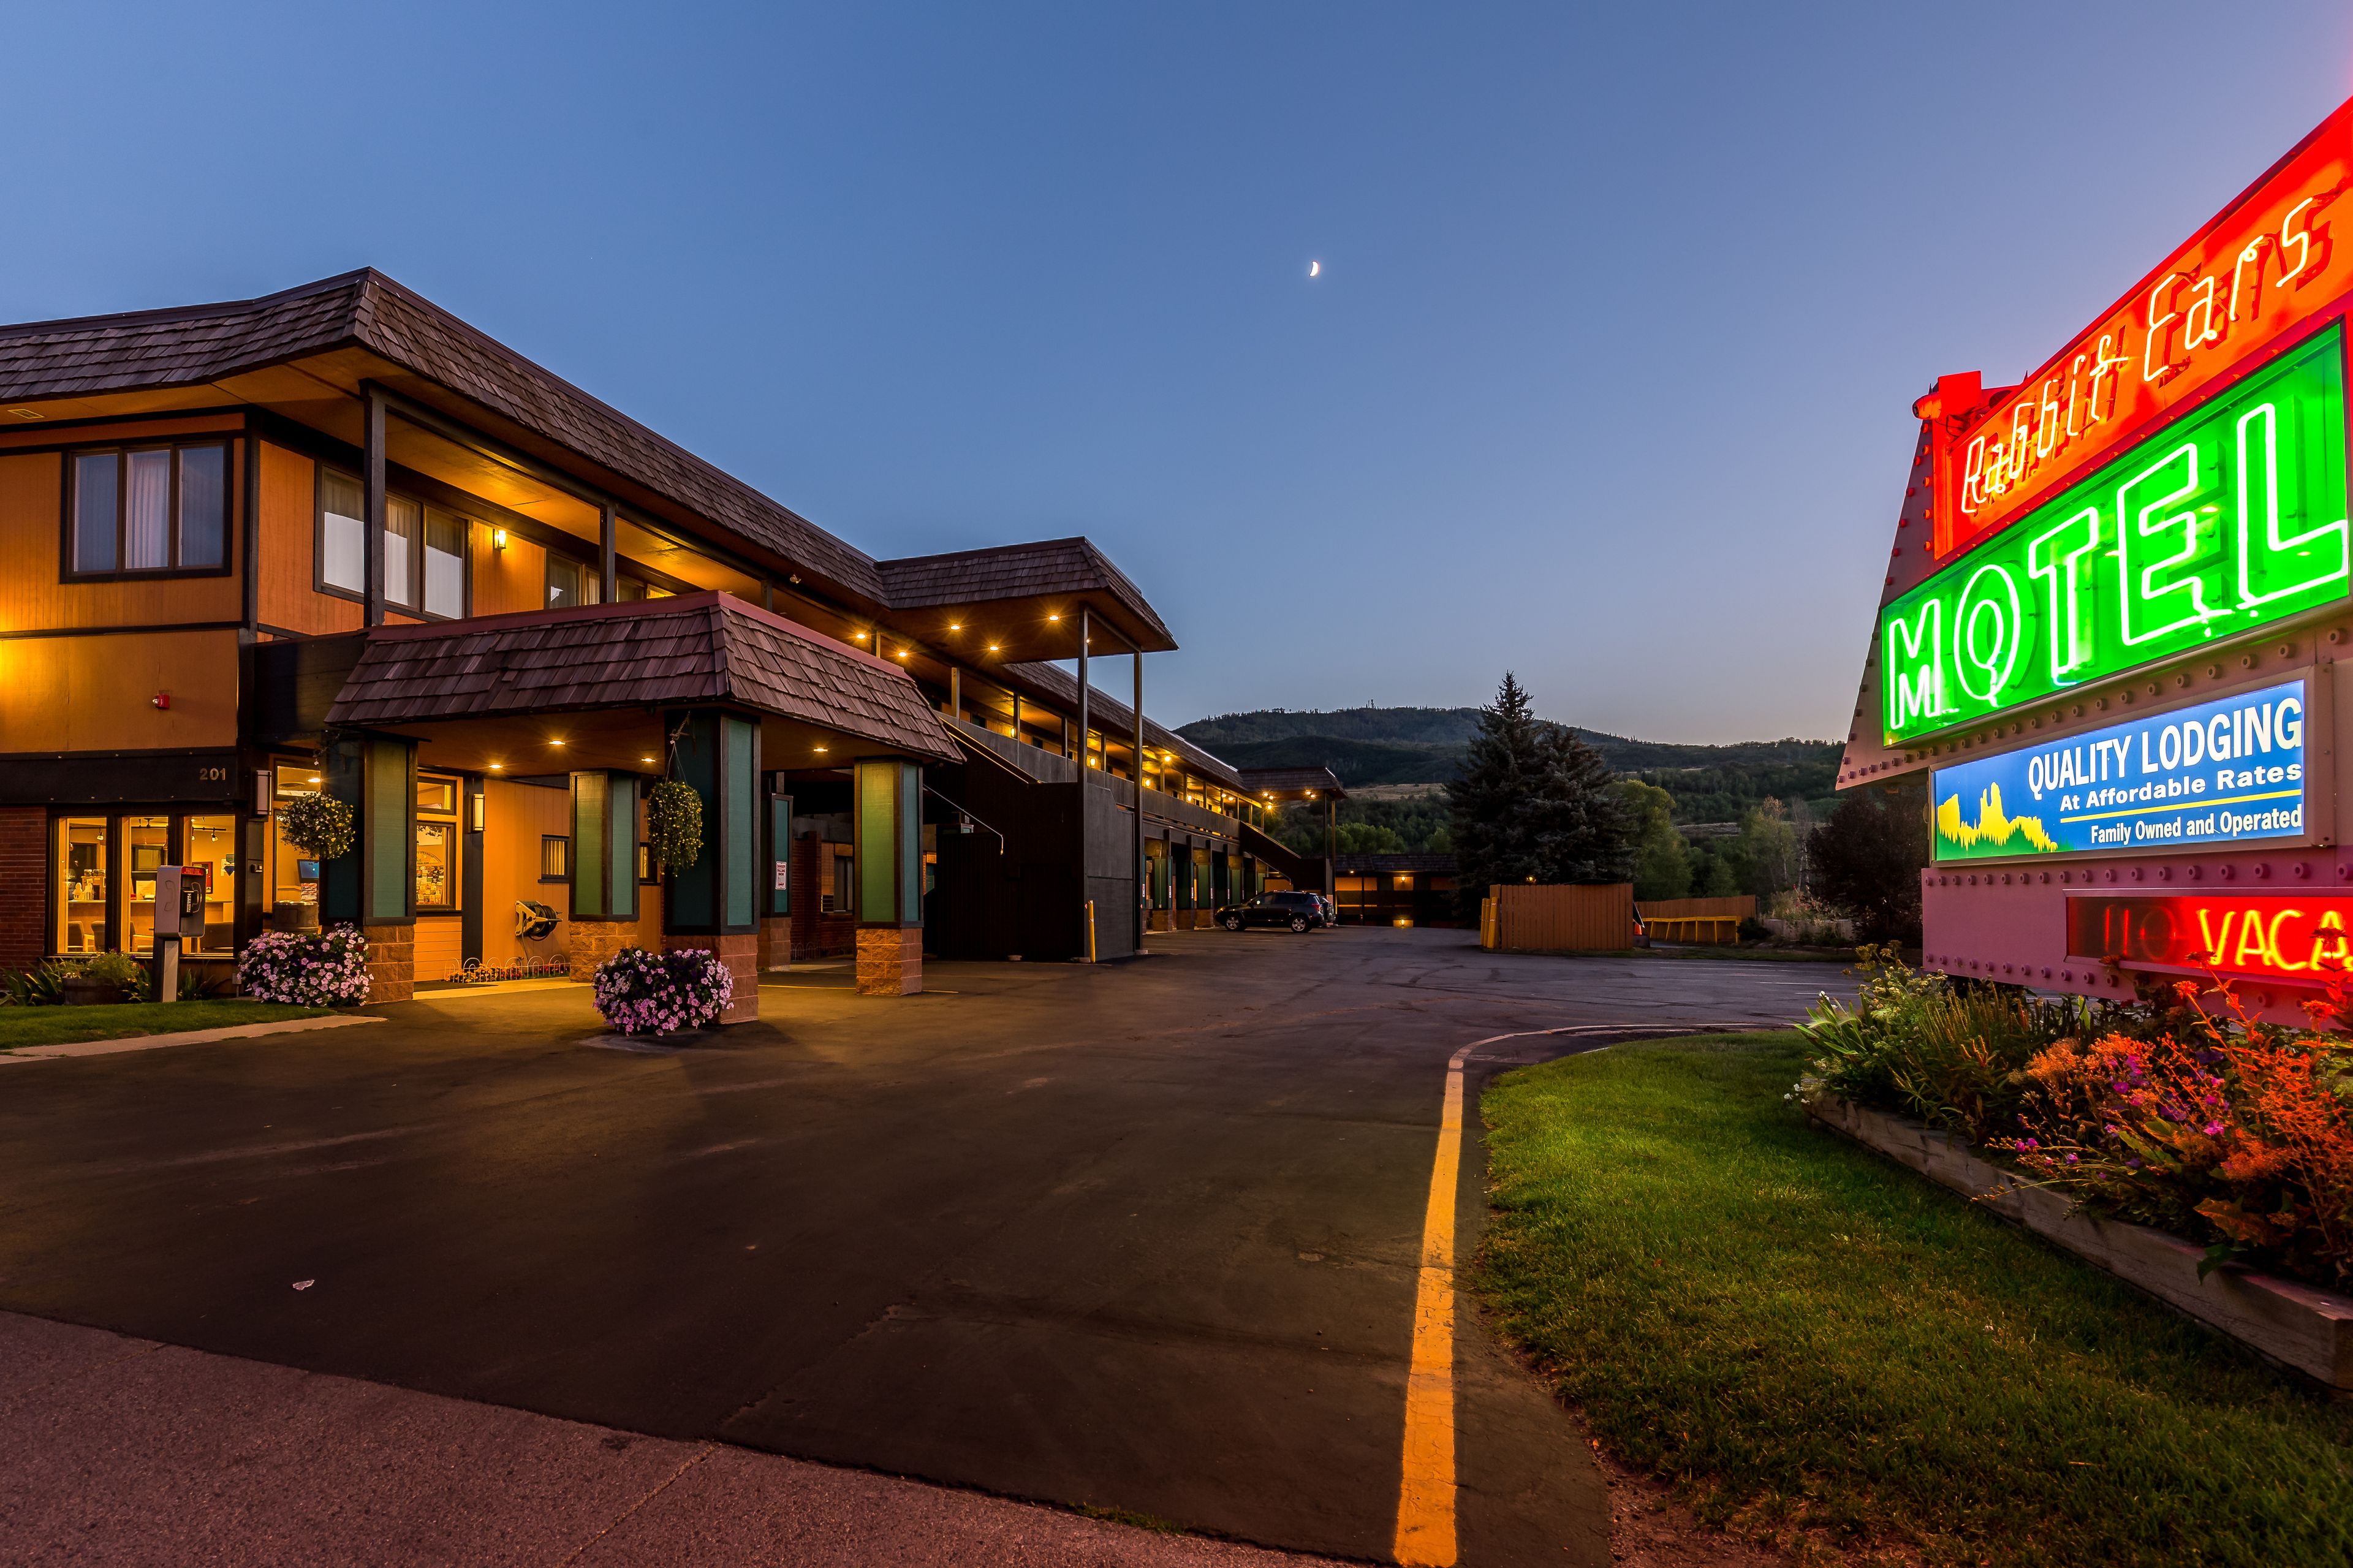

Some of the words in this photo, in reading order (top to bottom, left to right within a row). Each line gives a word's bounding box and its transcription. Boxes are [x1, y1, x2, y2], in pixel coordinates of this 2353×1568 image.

[1961, 334, 2129, 514] Rabbit
[2143, 197, 2314, 382] Ears
[1888, 402, 2349, 730] MOTEL
[199, 768, 225, 781] 201
[2028, 735, 2132, 801] QUALITY
[2142, 697, 2302, 774] LODGING
[2059, 795, 2080, 812] At
[2086, 775, 2206, 809] Affordable
[2217, 763, 2302, 790] Rates
[2091, 822, 2132, 846] Family
[2135, 816, 2181, 840] Owned
[2186, 812, 2215, 836] and
[2219, 803, 2302, 837] Operated
